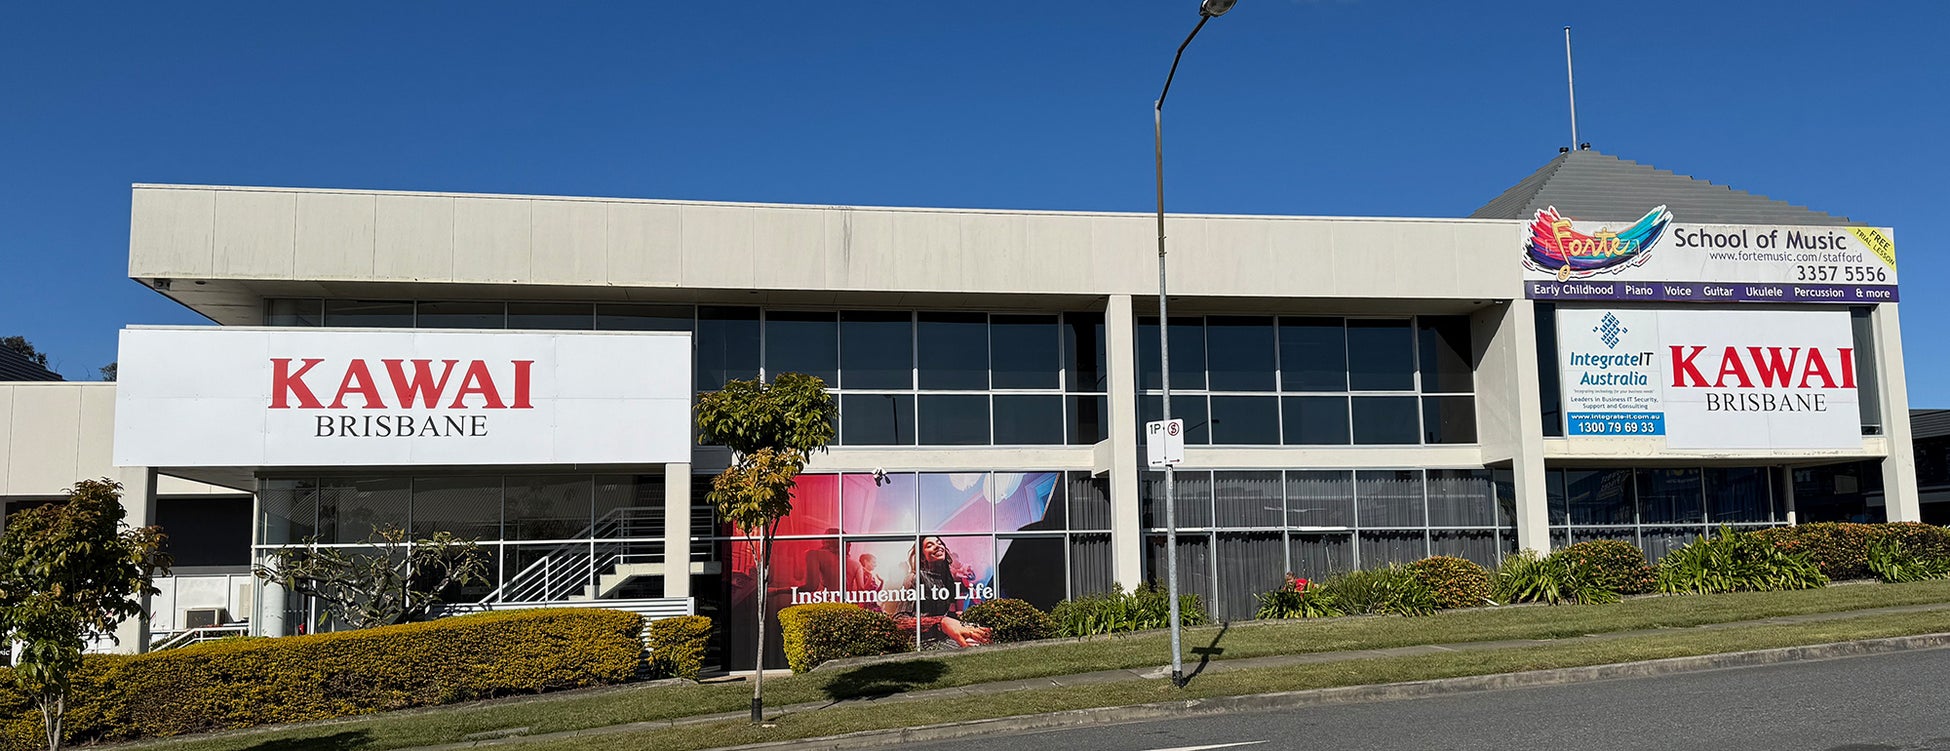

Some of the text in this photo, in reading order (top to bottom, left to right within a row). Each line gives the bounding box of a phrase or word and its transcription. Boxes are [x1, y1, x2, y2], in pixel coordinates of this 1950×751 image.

[1674, 228, 1847, 250] School of Music
[1856, 228, 1895, 265] TRIAL LESSON
[1869, 230, 1891, 251] FREE
[1551, 219, 1630, 280] Forte
[1709, 250, 1863, 263] www.fortemusic.com/stafford
[1797, 265, 1886, 282] 3357 5556
[1534, 284, 1891, 298] Early Childhood Piano Voice Guitar Ukulele Percussion & more
[1570, 352, 1654, 369] IntegrateIT
[1668, 345, 1858, 389] KAWAI
[269, 358, 535, 409] KAWAI
[1580, 371, 1648, 385] Australia
[1706, 393, 1827, 412] BRISBANE
[315, 415, 488, 437] BRISBANE
[1150, 423, 1161, 435] 1P
[1579, 422, 1654, 433] 1300 79 69 33
[931, 585, 950, 600] to
[954, 582, 993, 600] Life
